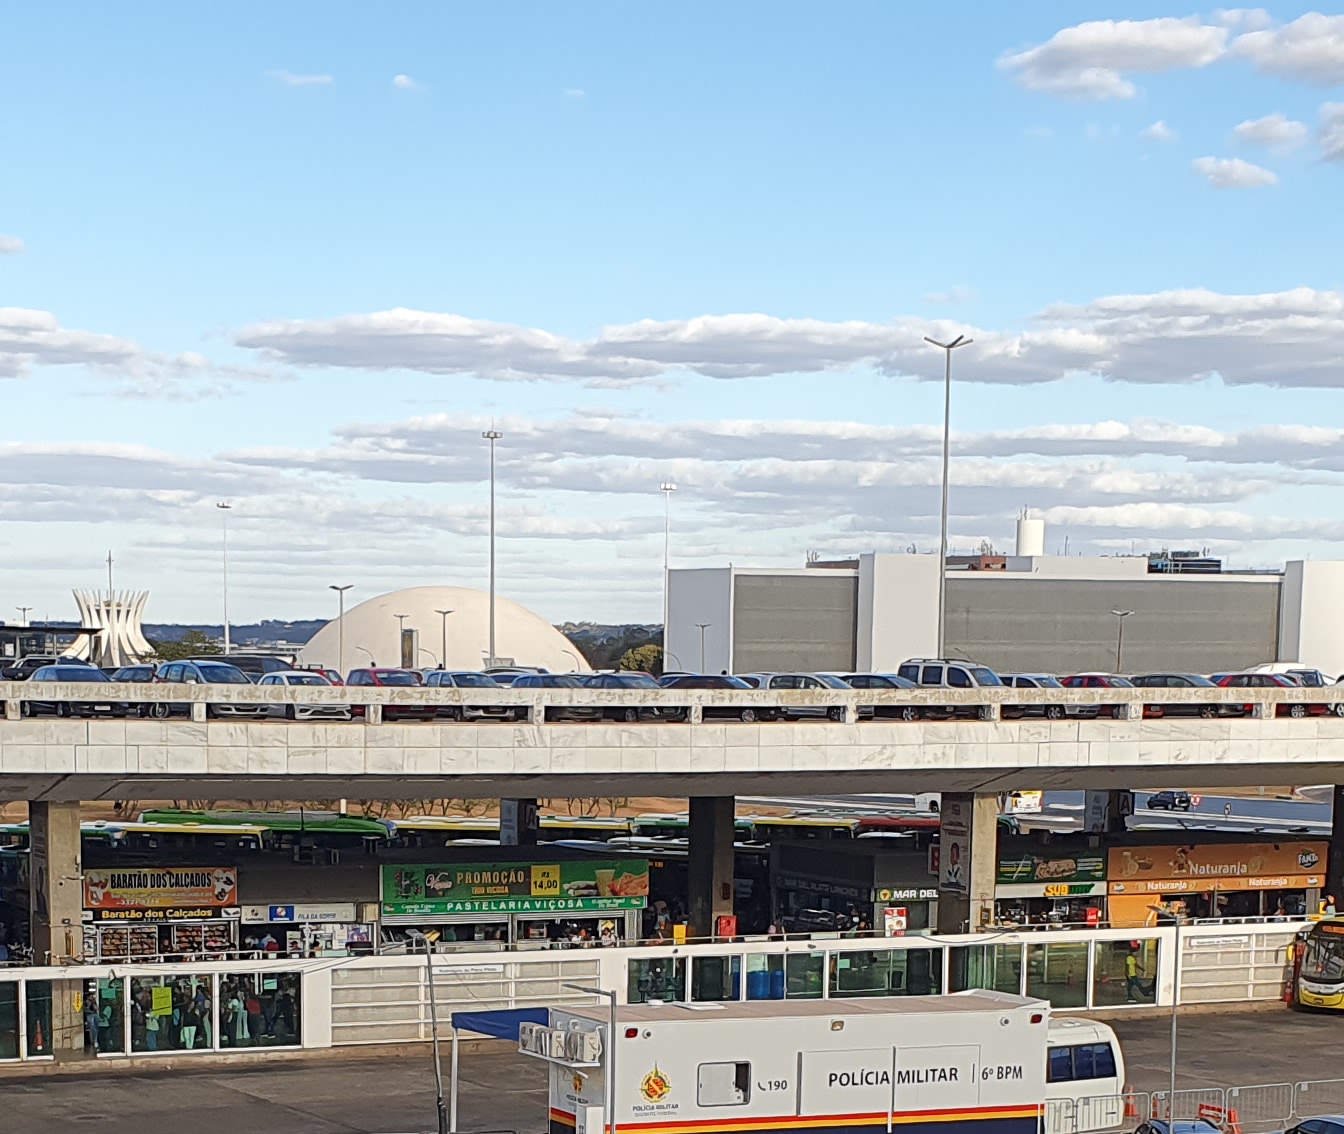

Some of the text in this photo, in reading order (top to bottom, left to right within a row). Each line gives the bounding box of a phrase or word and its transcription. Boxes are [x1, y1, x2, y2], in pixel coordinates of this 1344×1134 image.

[1189, 861, 1248, 876] Naturanja
[110, 871, 212, 889] BARATÃO DOS CALÇADOS
[457, 869, 525, 885] PROMOÇÃO
[533, 879, 558, 891] 14,00
[893, 888, 939, 899] MAR DEL
[446, 901, 531, 911] PASTELARIA
[534, 898, 584, 911] VIÇOSA
[144, 909, 164, 919] dos
[828, 1068, 959, 1087] POLÍCIA MILITAR
[996, 1066, 1023, 1080] BPM
[768, 1080, 788, 1091] 190
